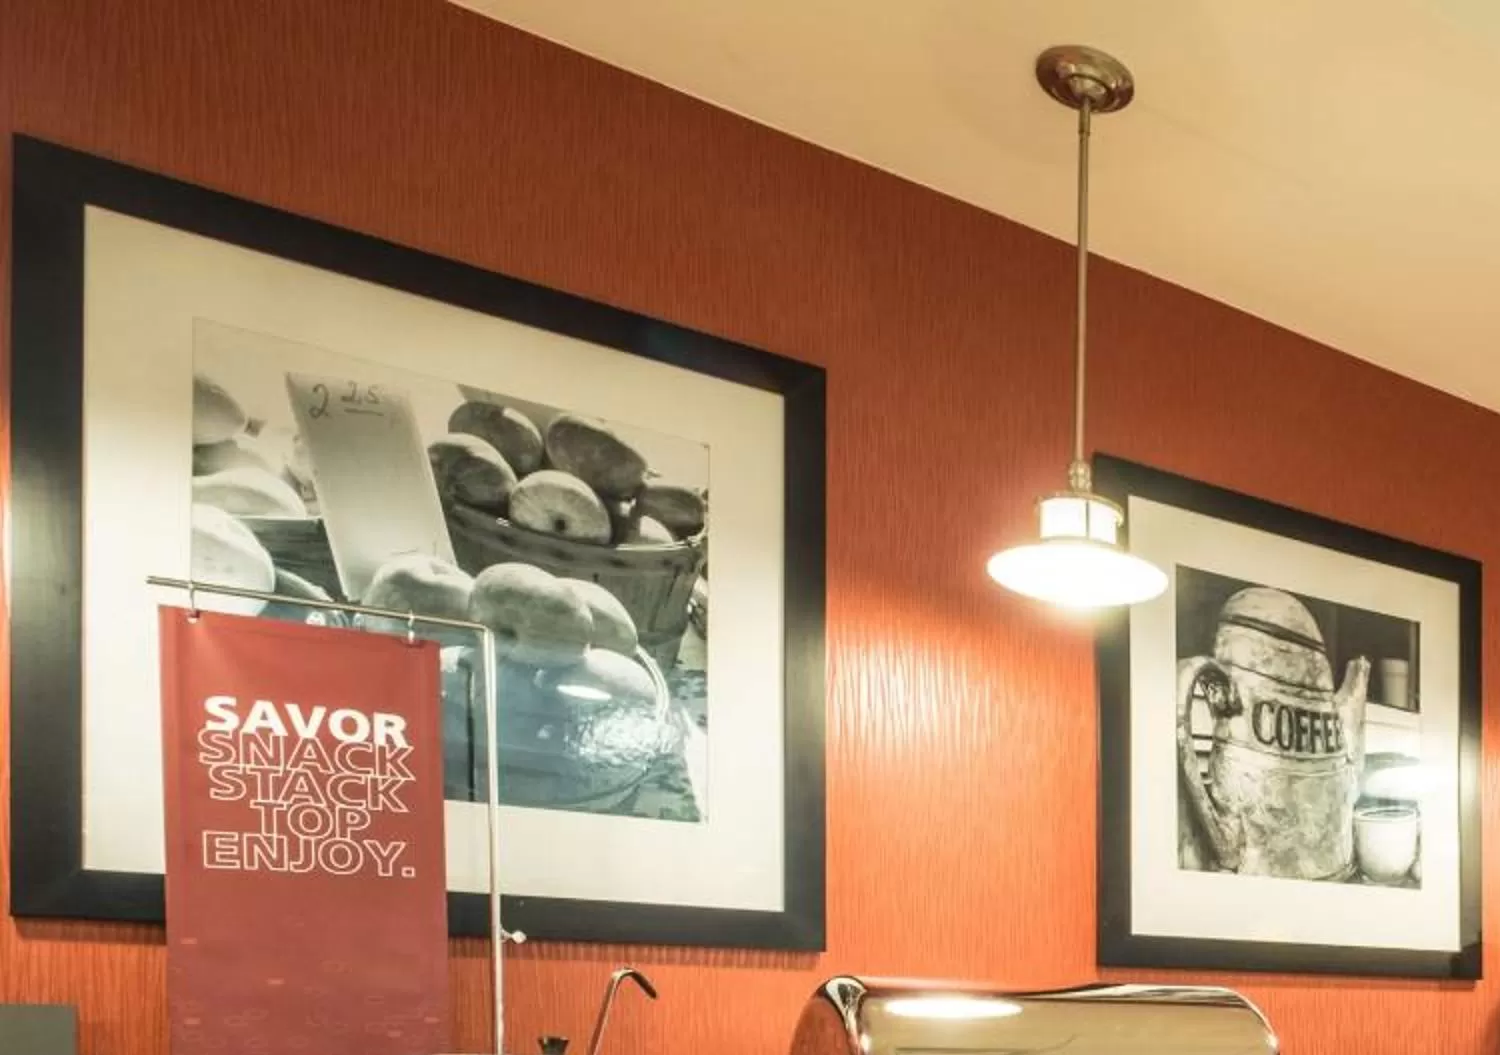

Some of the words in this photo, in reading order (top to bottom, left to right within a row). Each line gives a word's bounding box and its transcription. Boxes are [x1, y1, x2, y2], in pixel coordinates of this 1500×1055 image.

[204, 695, 407, 747] SAVOR
[198, 727, 416, 781] SNACK
[208, 762, 409, 812] STACK
[250, 799, 371, 839] TOP
[202, 830, 416, 877] ENJOY.
